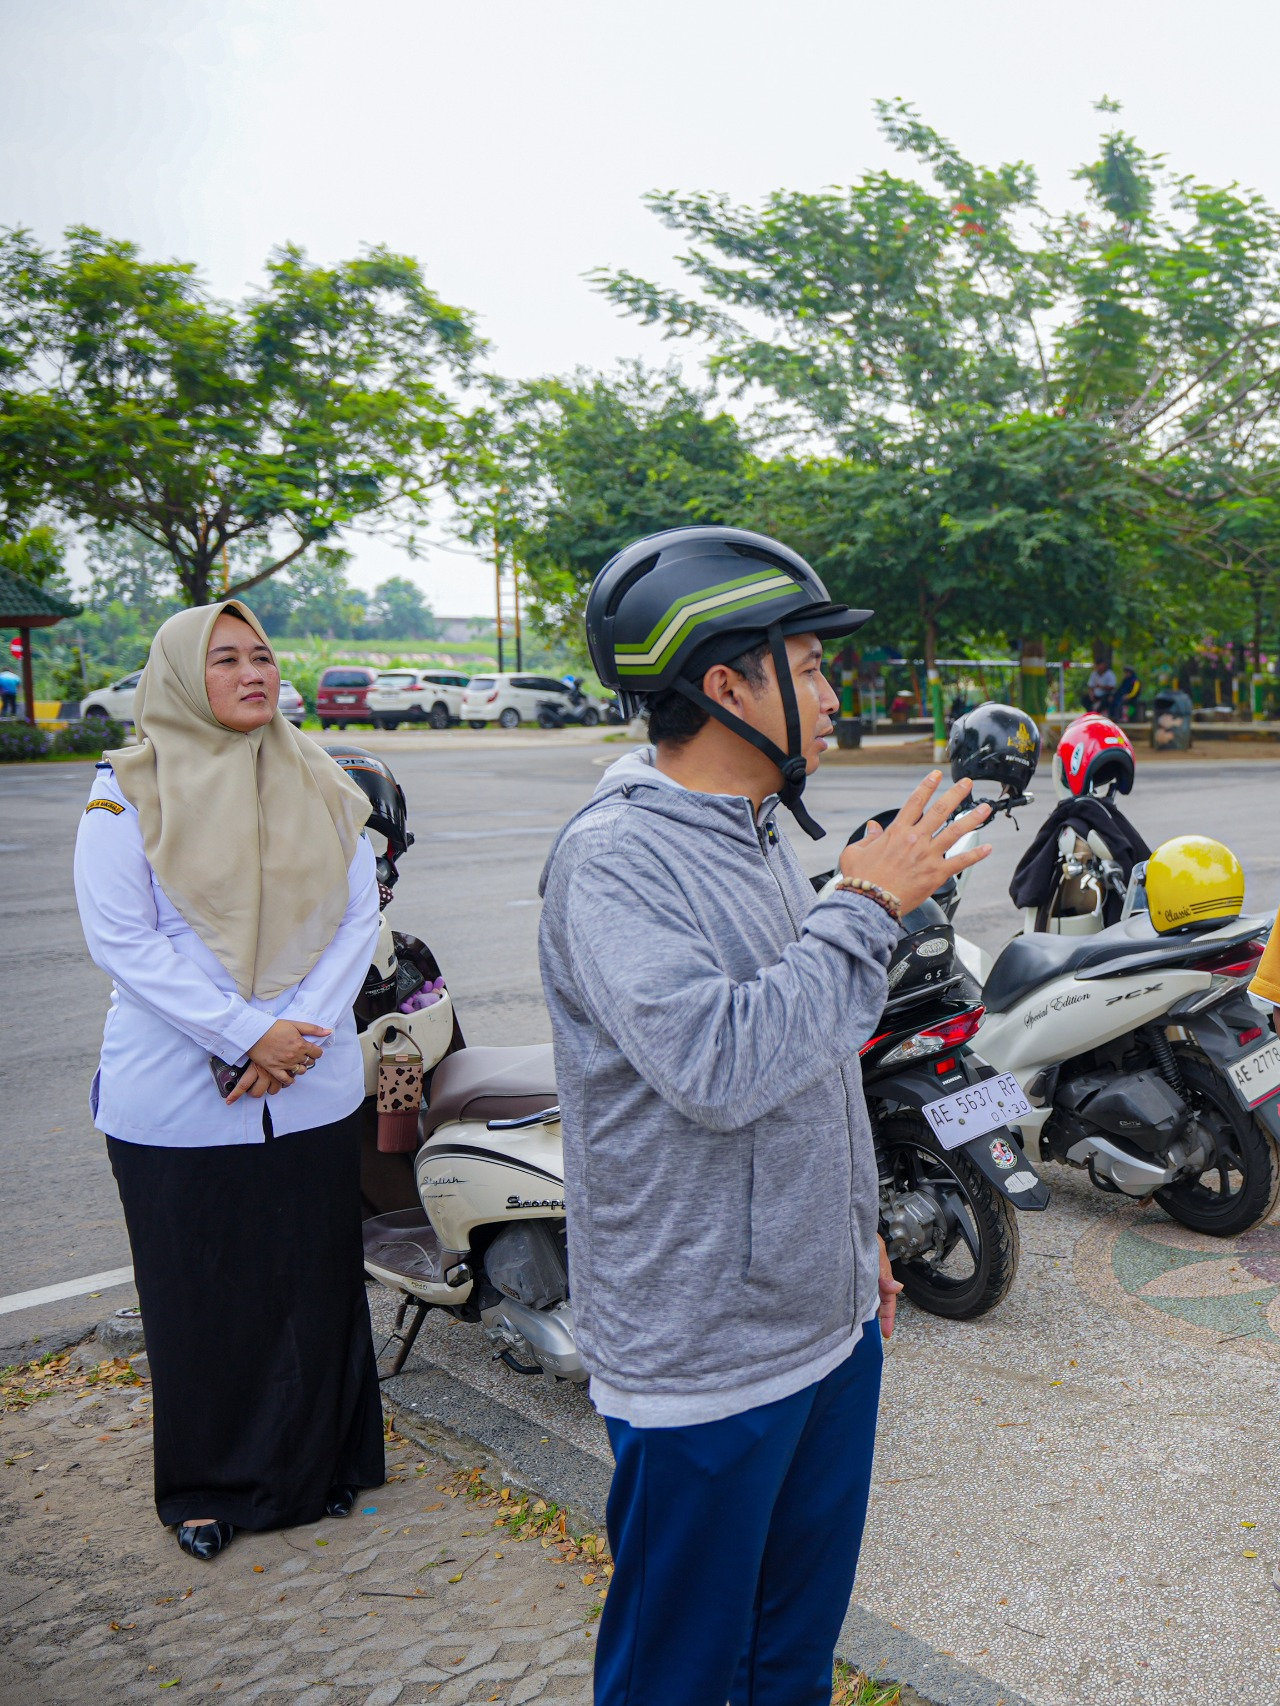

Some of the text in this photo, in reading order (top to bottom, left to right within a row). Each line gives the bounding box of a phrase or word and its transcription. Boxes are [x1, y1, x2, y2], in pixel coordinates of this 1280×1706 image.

[1164, 906, 1192, 923] Classic
[1105, 982, 1164, 1006] PCX
[1023, 993, 1091, 1029] Special Edition
[1234, 1065, 1252, 1086] AE
[930, 1076, 1016, 1127] AE 5637 RF
